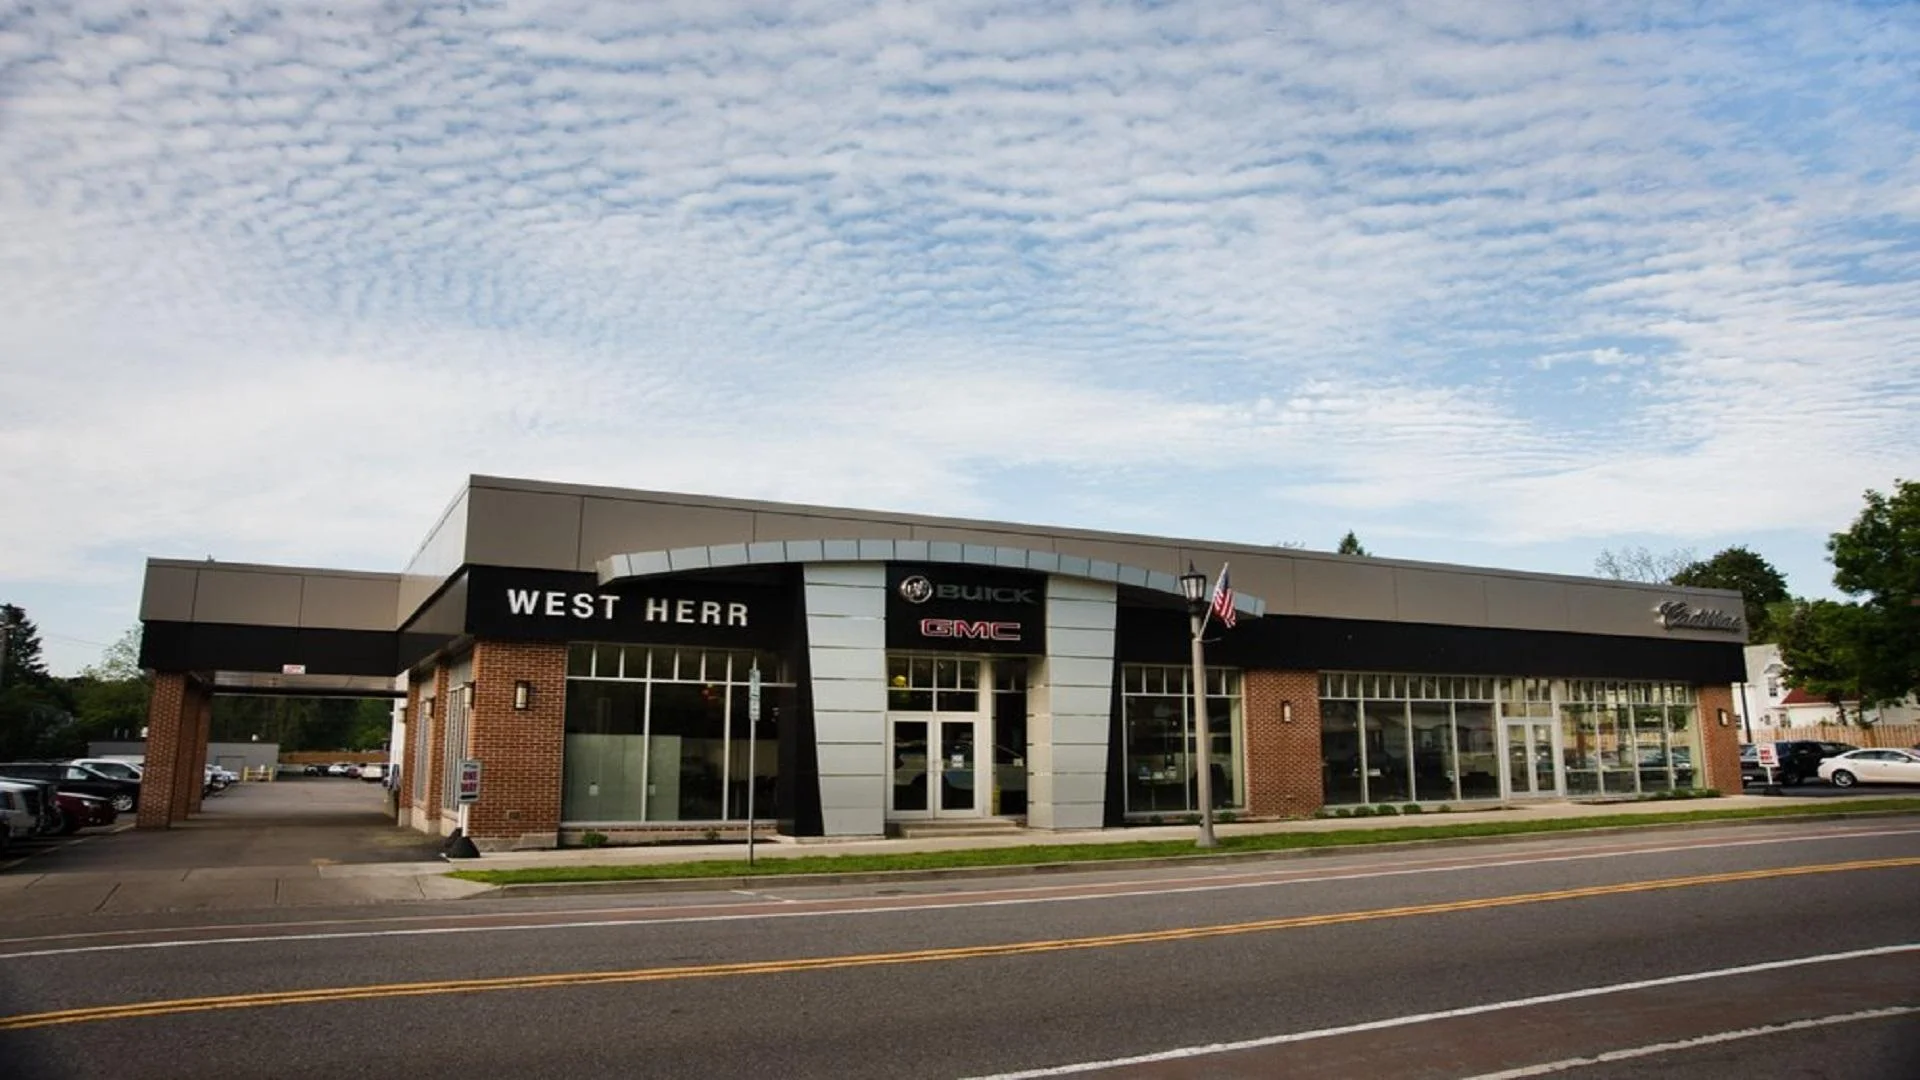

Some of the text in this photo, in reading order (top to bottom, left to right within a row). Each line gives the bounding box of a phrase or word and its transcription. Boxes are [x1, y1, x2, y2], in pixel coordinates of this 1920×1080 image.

[507, 589, 748, 626] WEST HERR
[936, 584, 1039, 605] BUICK
[921, 618, 1020, 640] GMC
[1657, 601, 1742, 631] Cadillac
